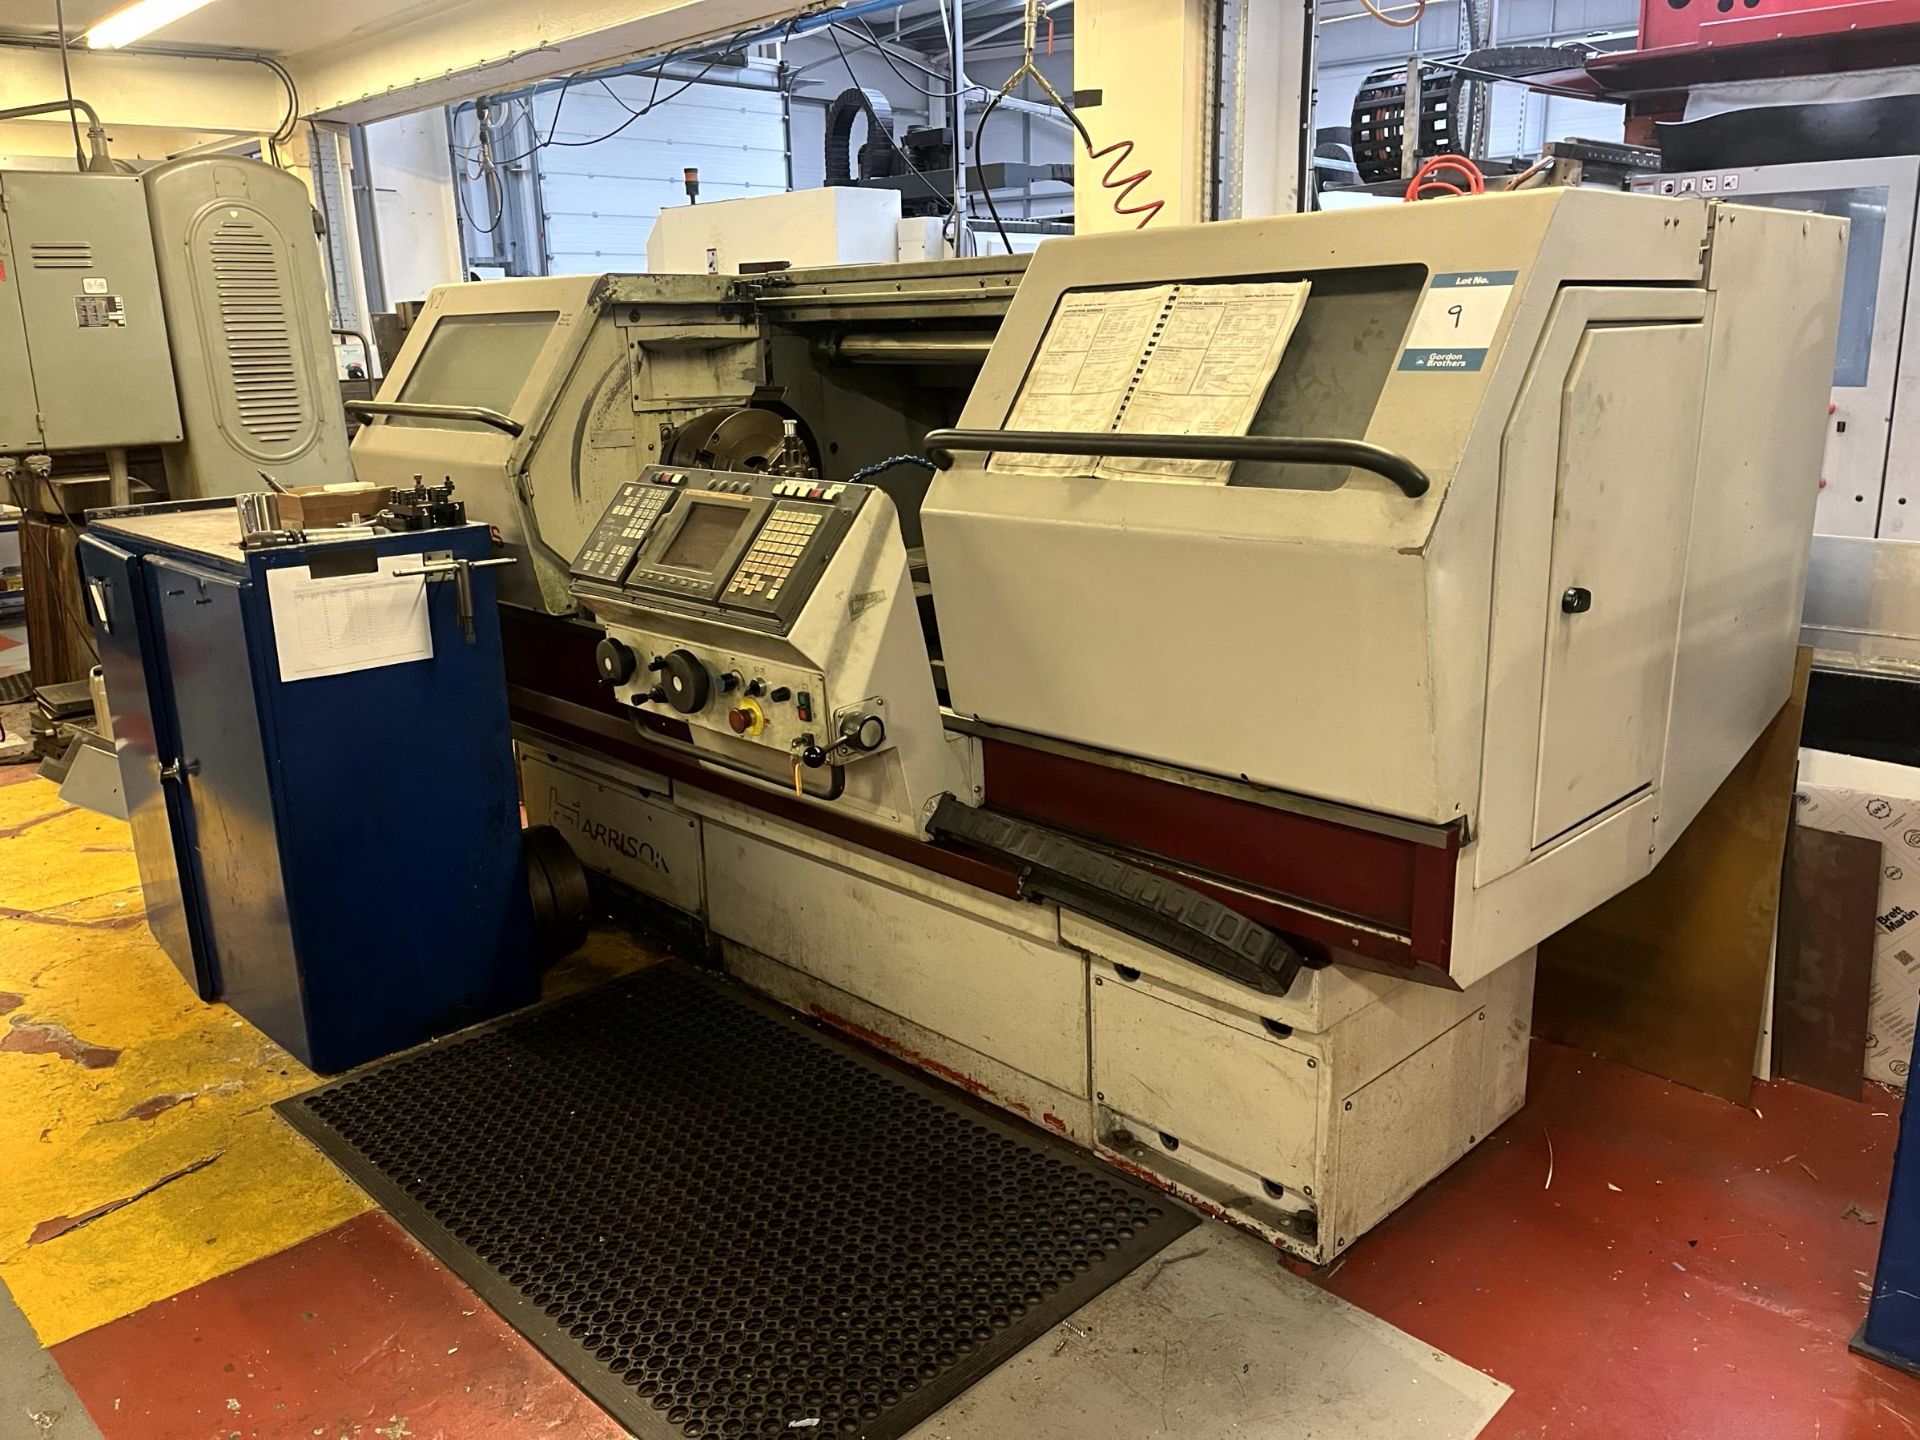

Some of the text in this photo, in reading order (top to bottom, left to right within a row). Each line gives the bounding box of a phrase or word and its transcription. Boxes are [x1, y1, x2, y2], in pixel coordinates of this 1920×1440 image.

[1455, 276, 1490, 285] Lot No.
[1447, 304, 1463, 329] 9
[1426, 359, 1467, 367] Brothers
[1877, 905, 1905, 925] Brett
[1885, 910, 1919, 933] Martin
